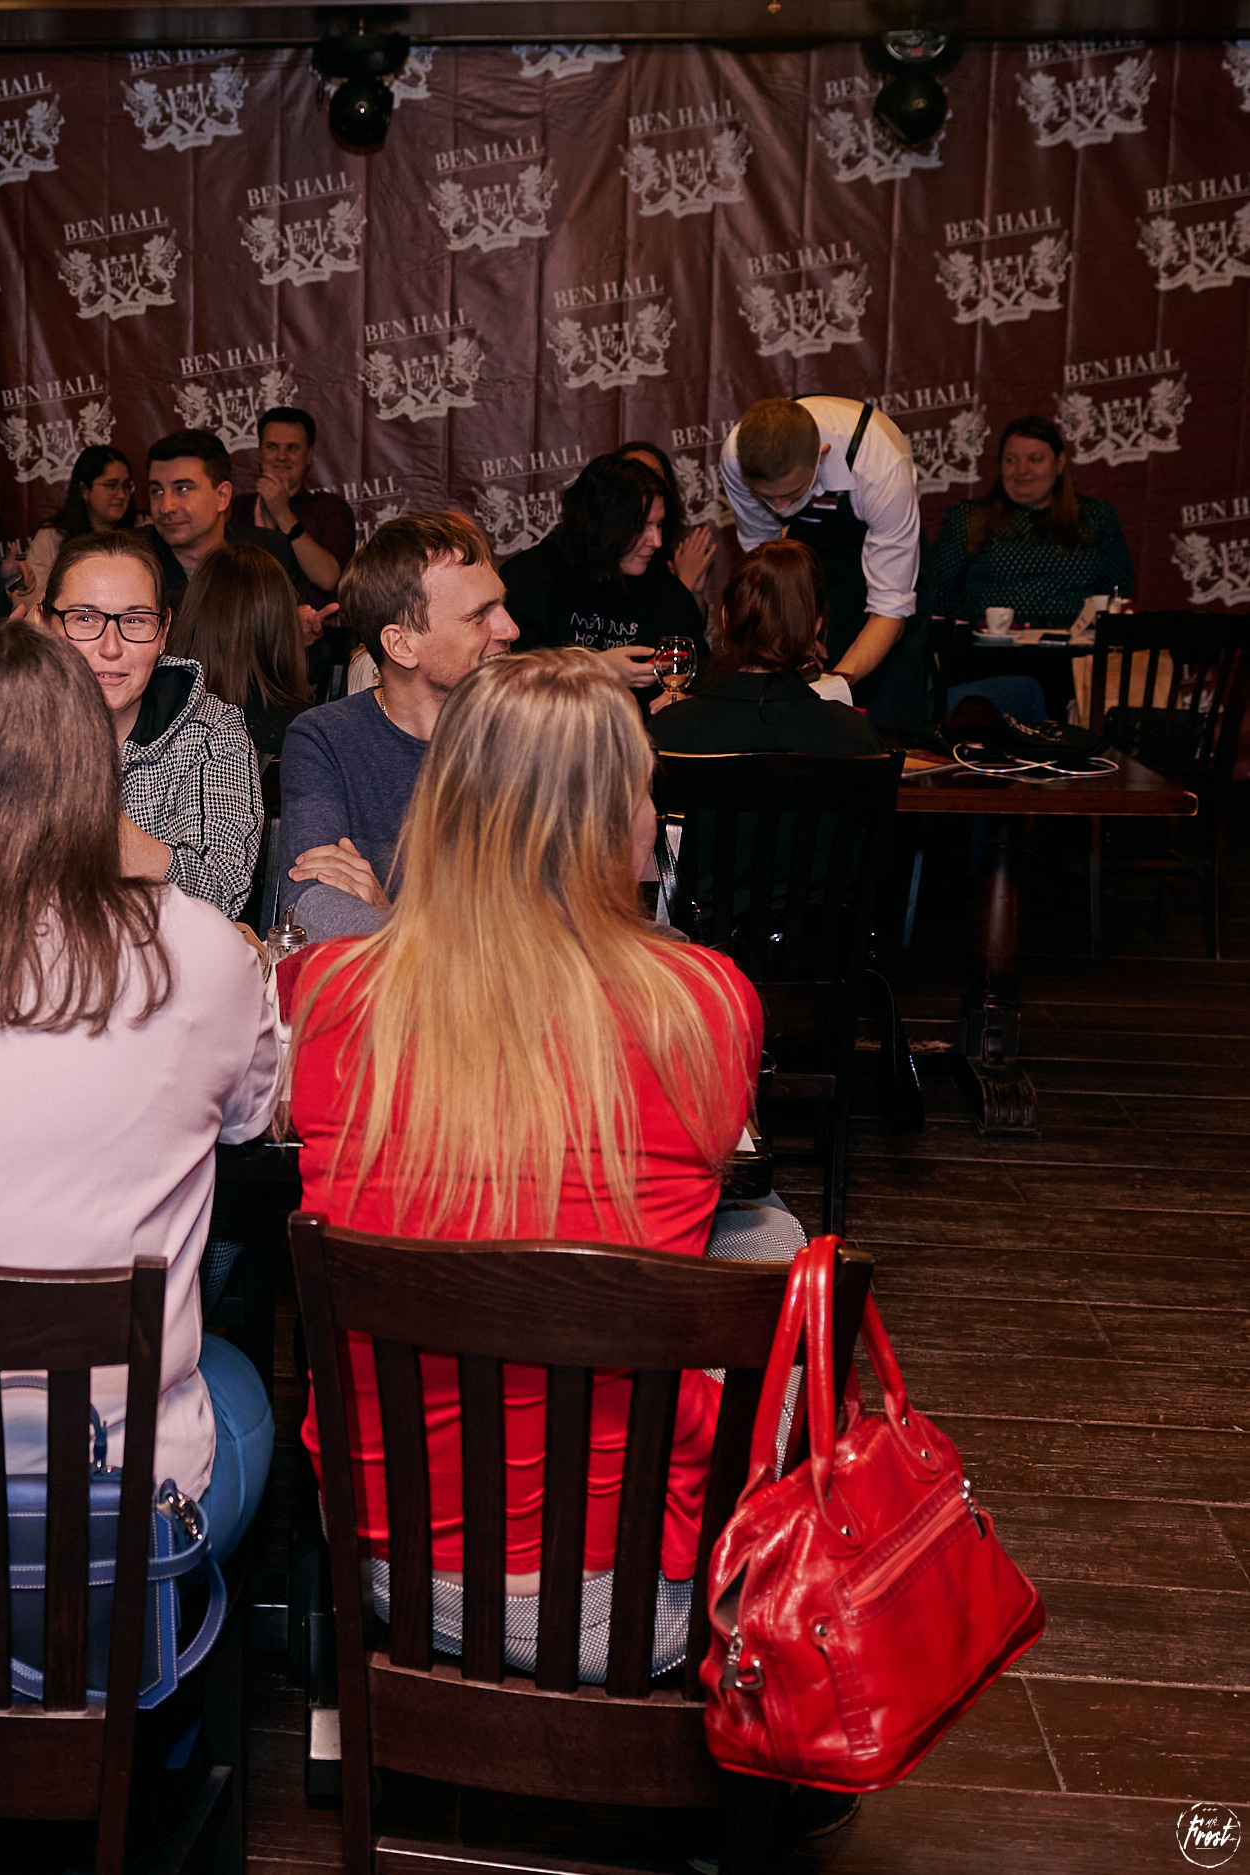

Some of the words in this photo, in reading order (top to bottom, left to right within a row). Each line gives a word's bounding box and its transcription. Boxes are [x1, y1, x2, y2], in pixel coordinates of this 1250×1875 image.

[824, 75, 870, 100] BEN
[627, 110, 672, 135] BEN
[678, 99, 740, 126] HALL
[435, 146, 479, 171] BEN
[484, 136, 544, 162] HALL
[246, 182, 289, 207] BEN
[296, 171, 354, 199] HALL
[1145, 181, 1193, 208] BEN
[1201, 173, 1250, 199] HAL
[63, 216, 105, 241] BEN
[110, 206, 169, 233] HALL
[944, 217, 990, 242] BEN
[996, 205, 1061, 234] HALL
[748, 251, 791, 275] BEN
[797, 240, 860, 267] HALL
[553, 286, 598, 310] BEN
[603, 274, 664, 300] HALL
[364, 319, 407, 343] BEN
[412, 308, 472, 334] HALL
[180, 352, 222, 376] BEN
[227, 341, 286, 368] HALL
[1063, 358, 1110, 385] BEN
[1115, 348, 1180, 376] HALL
[1, 386, 41, 407] BEN
[45, 373, 104, 400] HALL
[915, 380, 980, 407] HALL
[671, 424, 714, 448] BEN
[481, 455, 524, 479] BEN
[530, 444, 590, 470] HALL
[343, 476, 402, 501] HALL
[1181, 500, 1227, 524] BEN
